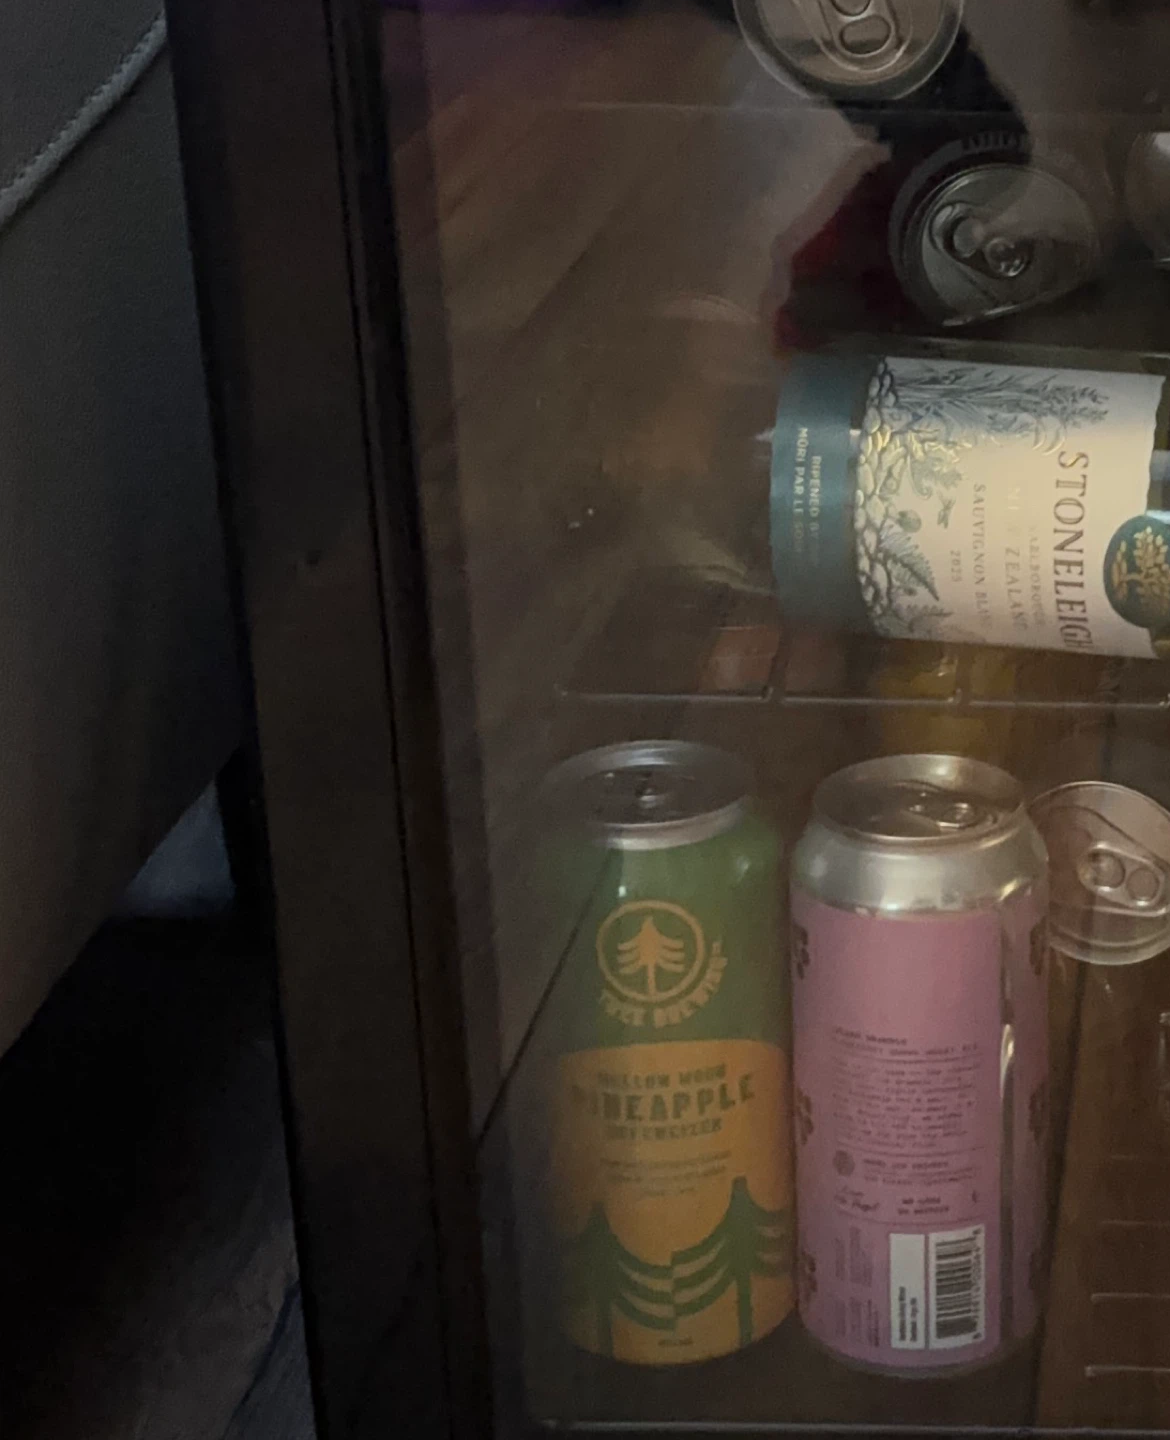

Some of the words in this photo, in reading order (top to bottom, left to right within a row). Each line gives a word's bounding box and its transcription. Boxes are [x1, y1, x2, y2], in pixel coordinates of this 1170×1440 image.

[793, 465, 806, 496] PAR
[809, 455, 822, 518] RIPENED
[973, 483, 987, 586] SAUVIGNON
[1053, 451, 1093, 648] STONELEIGH
